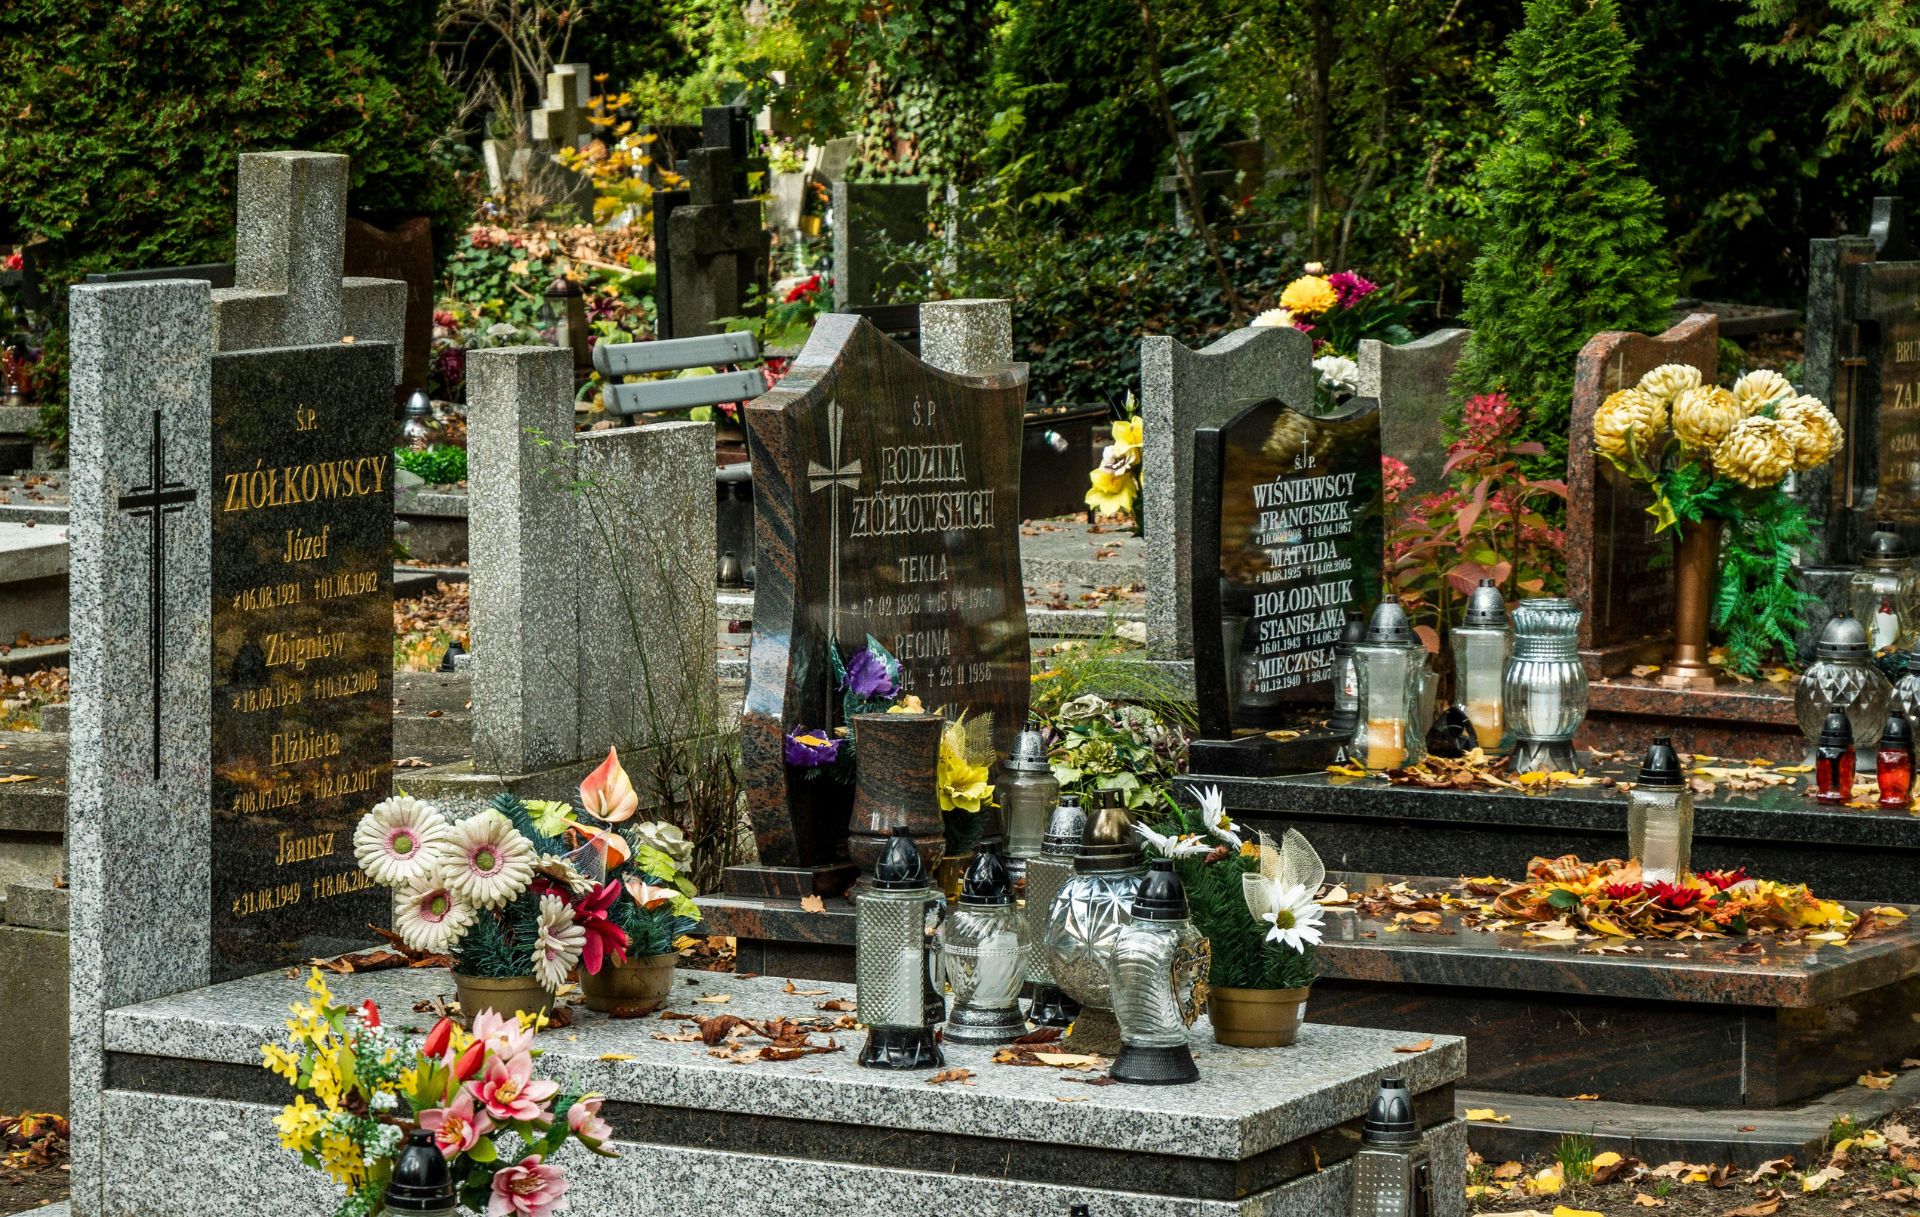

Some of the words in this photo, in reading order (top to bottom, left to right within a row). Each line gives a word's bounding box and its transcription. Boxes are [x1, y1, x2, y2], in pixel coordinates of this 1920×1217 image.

[881, 442, 966, 484] RODZINA
[224, 456, 387, 512] ZIÓŁKOWSCY
[1253, 474, 1356, 508] WIŚNIEWSCY
[850, 488, 995, 538] ZIÓŁKOWSKICH
[1259, 501, 1349, 531] FRANCISZEK
[1313, 521, 1352, 538] 14.04.1967
[284, 523, 330, 562] Józef
[1270, 540, 1338, 568] MATYLDA
[899, 553, 948, 583] TEKLA
[321, 571, 378, 599] 01.06.1982
[1253, 579, 1353, 618] HOŁODNIUK
[1260, 607, 1346, 640] STANISŁAWA
[265, 627, 346, 670] Zbigniew
[895, 628, 951, 660] REGINA
[1261, 636, 1301, 655] 16.01.1943
[1260, 675, 1300, 693] 01.12.1940
[271, 727, 340, 767] Elżbieta
[321, 768, 377, 799] 02.02.2017
[275, 832, 334, 866] Janusz
[241, 882, 301, 915] 31.08.1949
